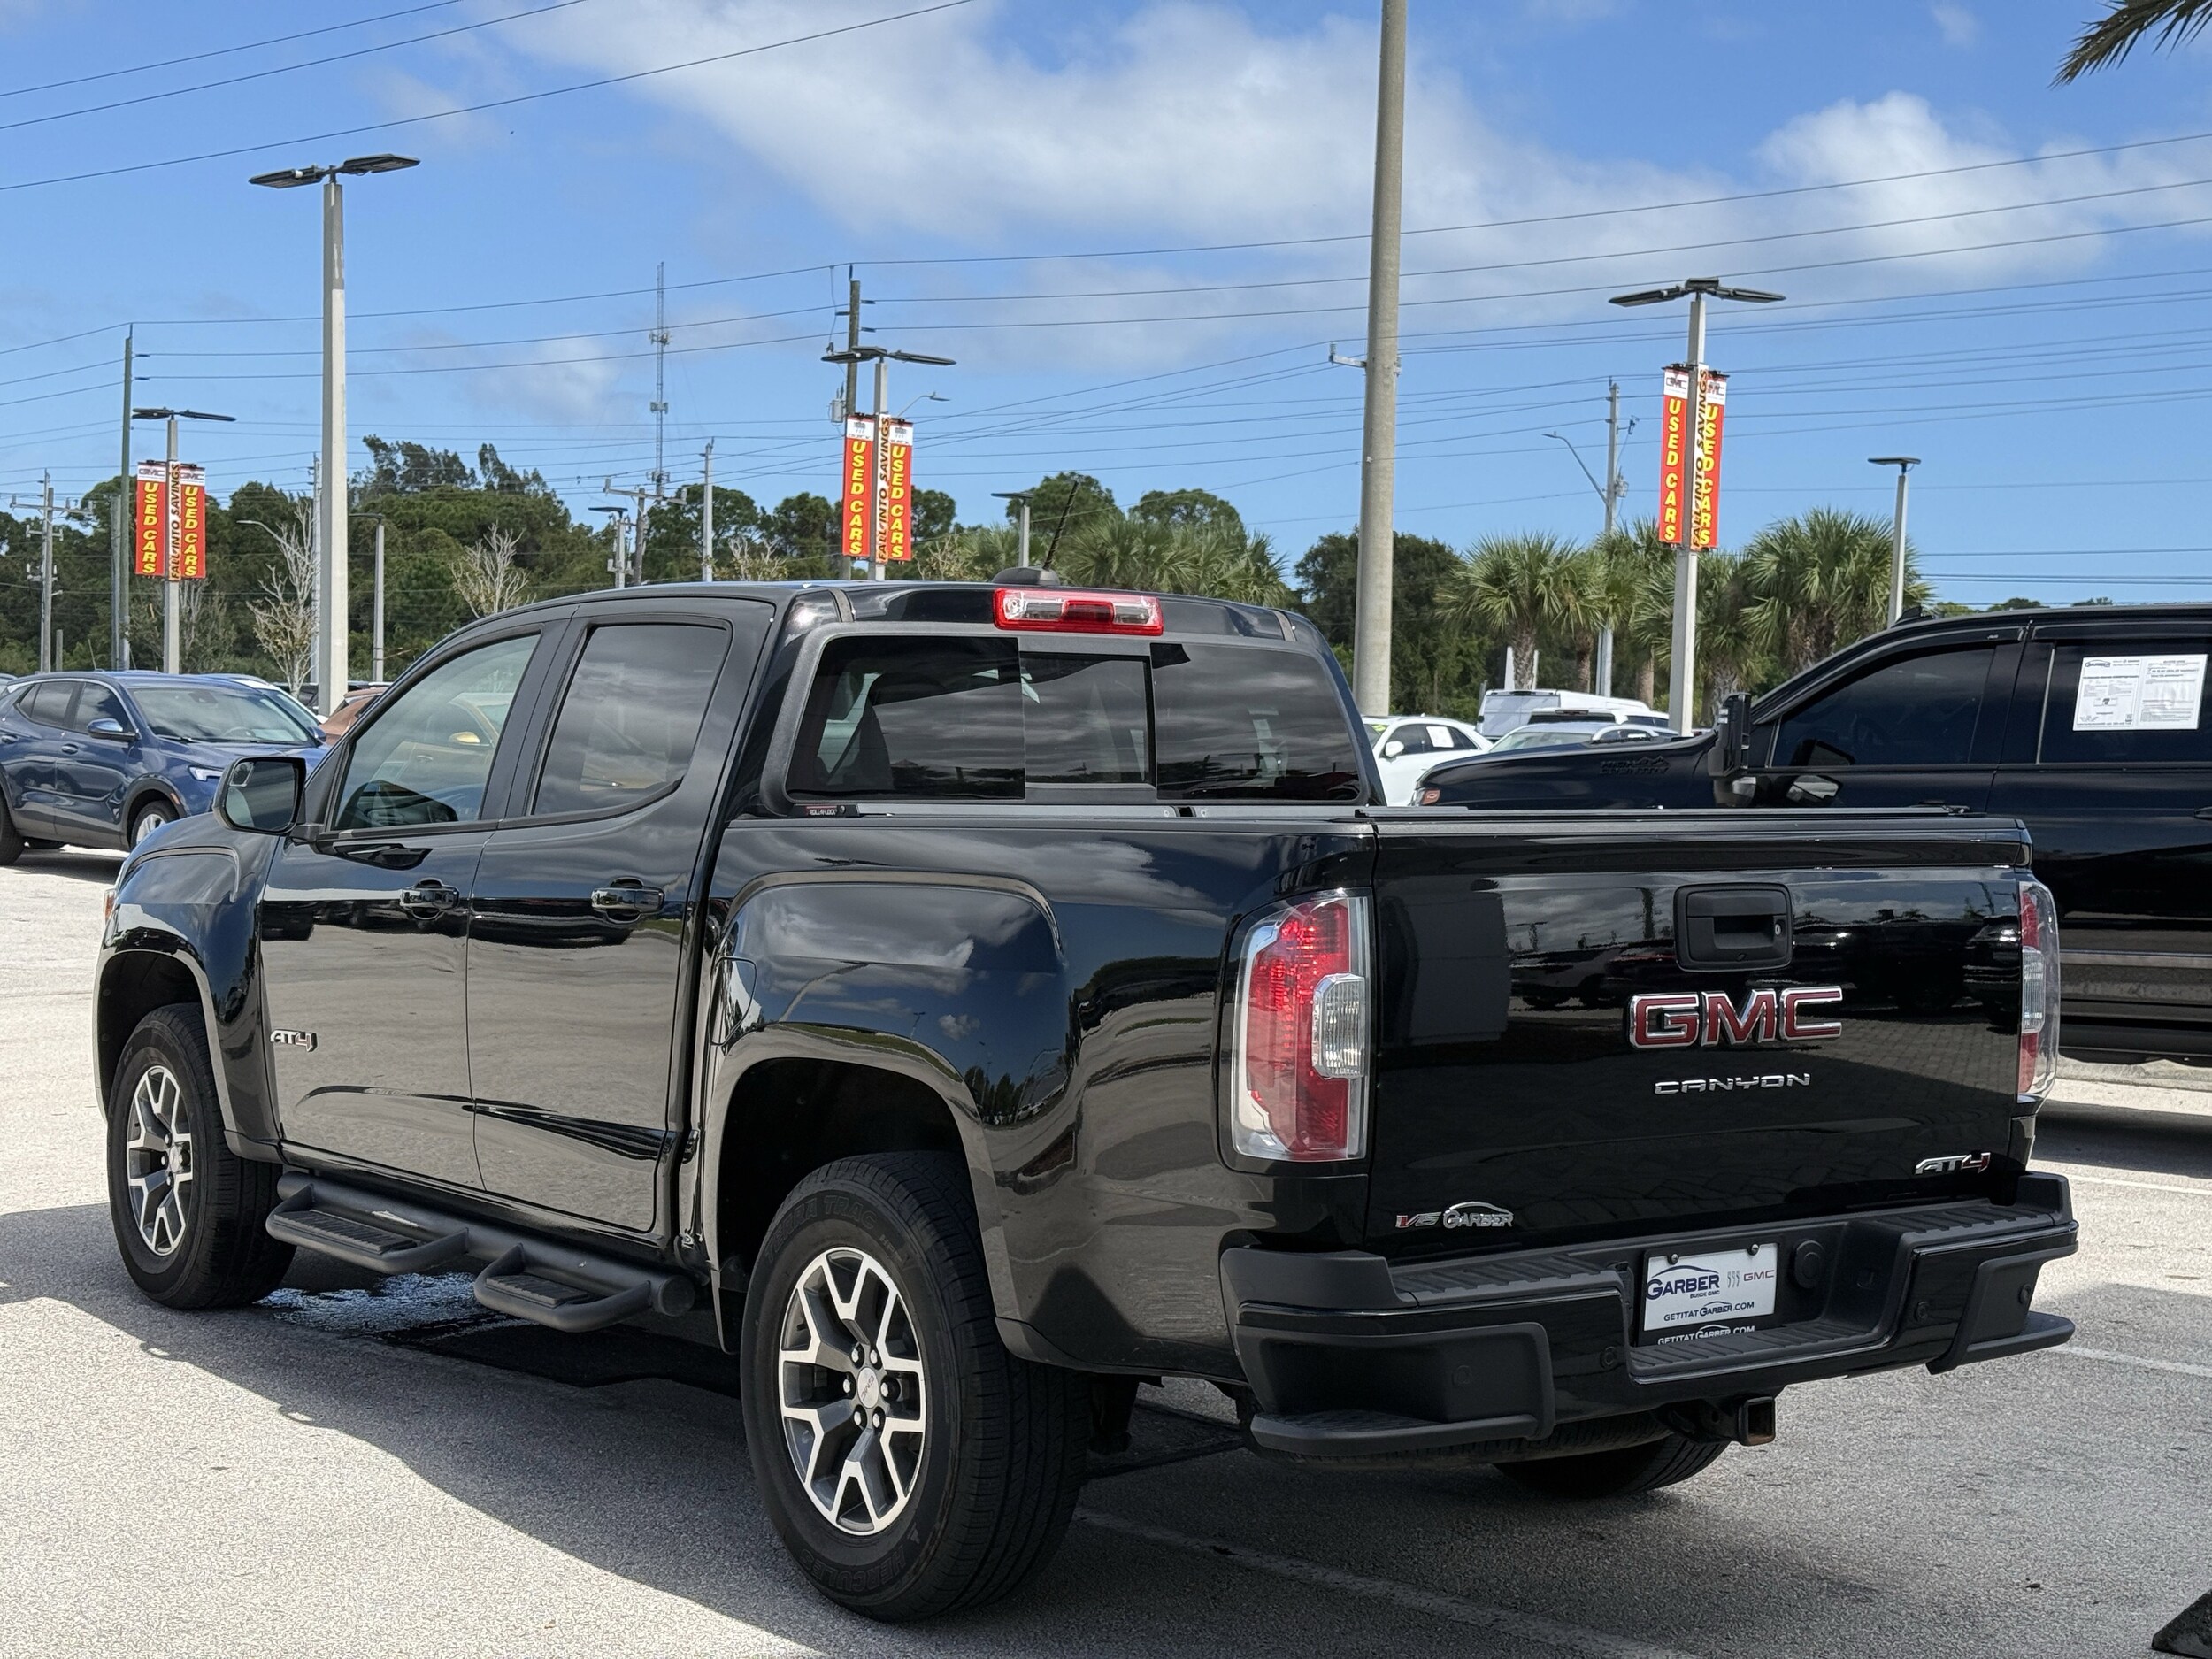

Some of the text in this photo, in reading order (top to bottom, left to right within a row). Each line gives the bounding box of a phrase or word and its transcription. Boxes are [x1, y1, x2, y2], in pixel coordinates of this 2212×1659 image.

[1666, 377, 1687, 389] GMC
[1665, 398, 1681, 467] USED
[1703, 404, 1718, 472] USED
[139, 468, 165, 477] GMC
[849, 440, 866, 495] USED
[891, 445, 906, 500] USED
[1693, 370, 1708, 548] FALL INTO SAVINGS
[142, 481, 159, 526] USED
[184, 486, 199, 529] USED
[878, 418, 890, 561] FALL INTO SAVINGS
[1664, 472, 1678, 541] CARS
[1700, 478, 1714, 545] CARS
[171, 464, 180, 580] FALL INTO SAVINGS
[849, 500, 864, 555] CARS
[890, 503, 904, 558] CARS
[142, 529, 158, 574] CARS
[183, 533, 198, 576] CARS
[1630, 986, 1843, 1048] GMC
[270, 1029, 316, 1052] AT4
[1655, 1073, 1810, 1095] CANYON
[1915, 1152, 1991, 1174] AT4
[823, 1194, 879, 1230] TRAC
[1395, 1211, 1442, 1228] V6
[1443, 1210, 1514, 1229] GARBER
[1646, 1274, 1720, 1300] GARBER
[1743, 1270, 1775, 1281] GMC
[861, 1375, 874, 1402] GMC
[799, 1544, 906, 1592] HERCULES
